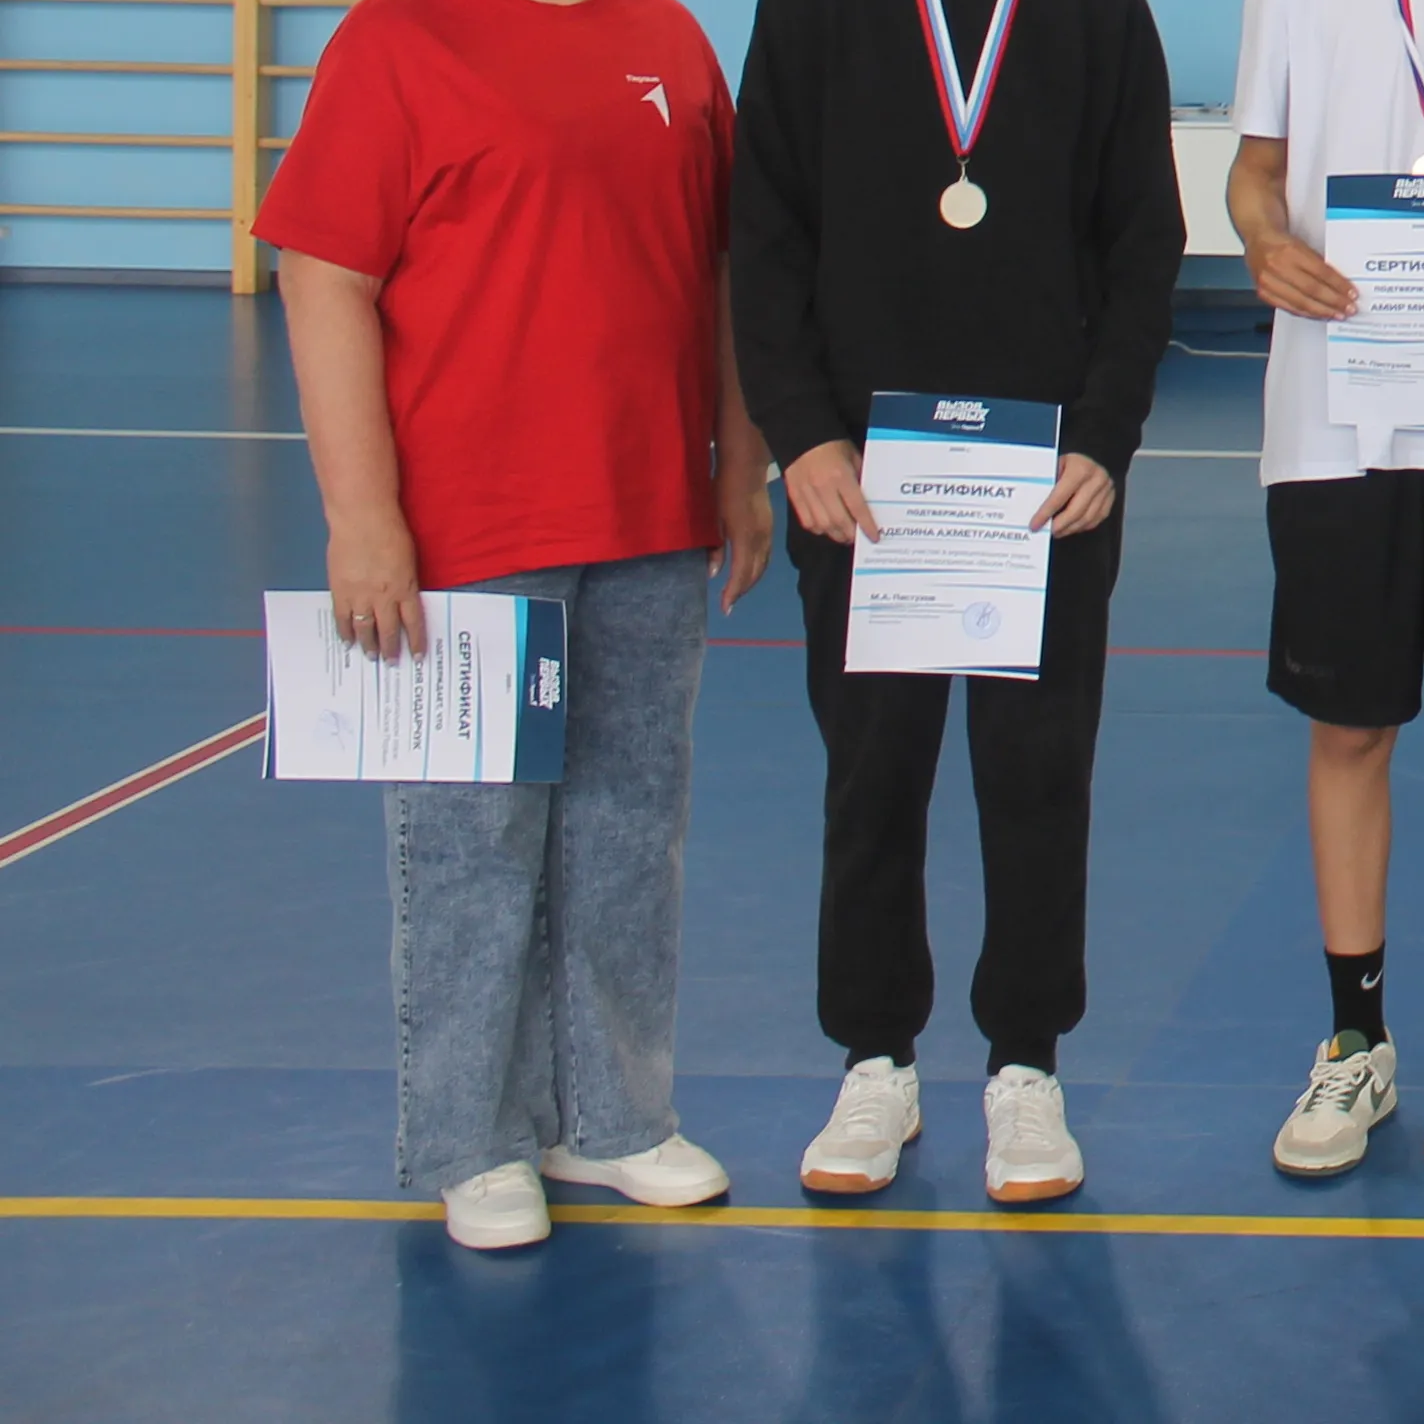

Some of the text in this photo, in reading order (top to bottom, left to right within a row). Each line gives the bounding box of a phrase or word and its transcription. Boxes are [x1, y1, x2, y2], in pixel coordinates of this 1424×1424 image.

[1371, 303, 1404, 312] АМИР
[900, 482, 1015, 499] СЕРТИФИКАТ
[878, 528, 1030, 542] АДЕЛИНА АХМЕТГАРАЕВА
[458, 630, 471, 740] СЕРТИФИКАТ
